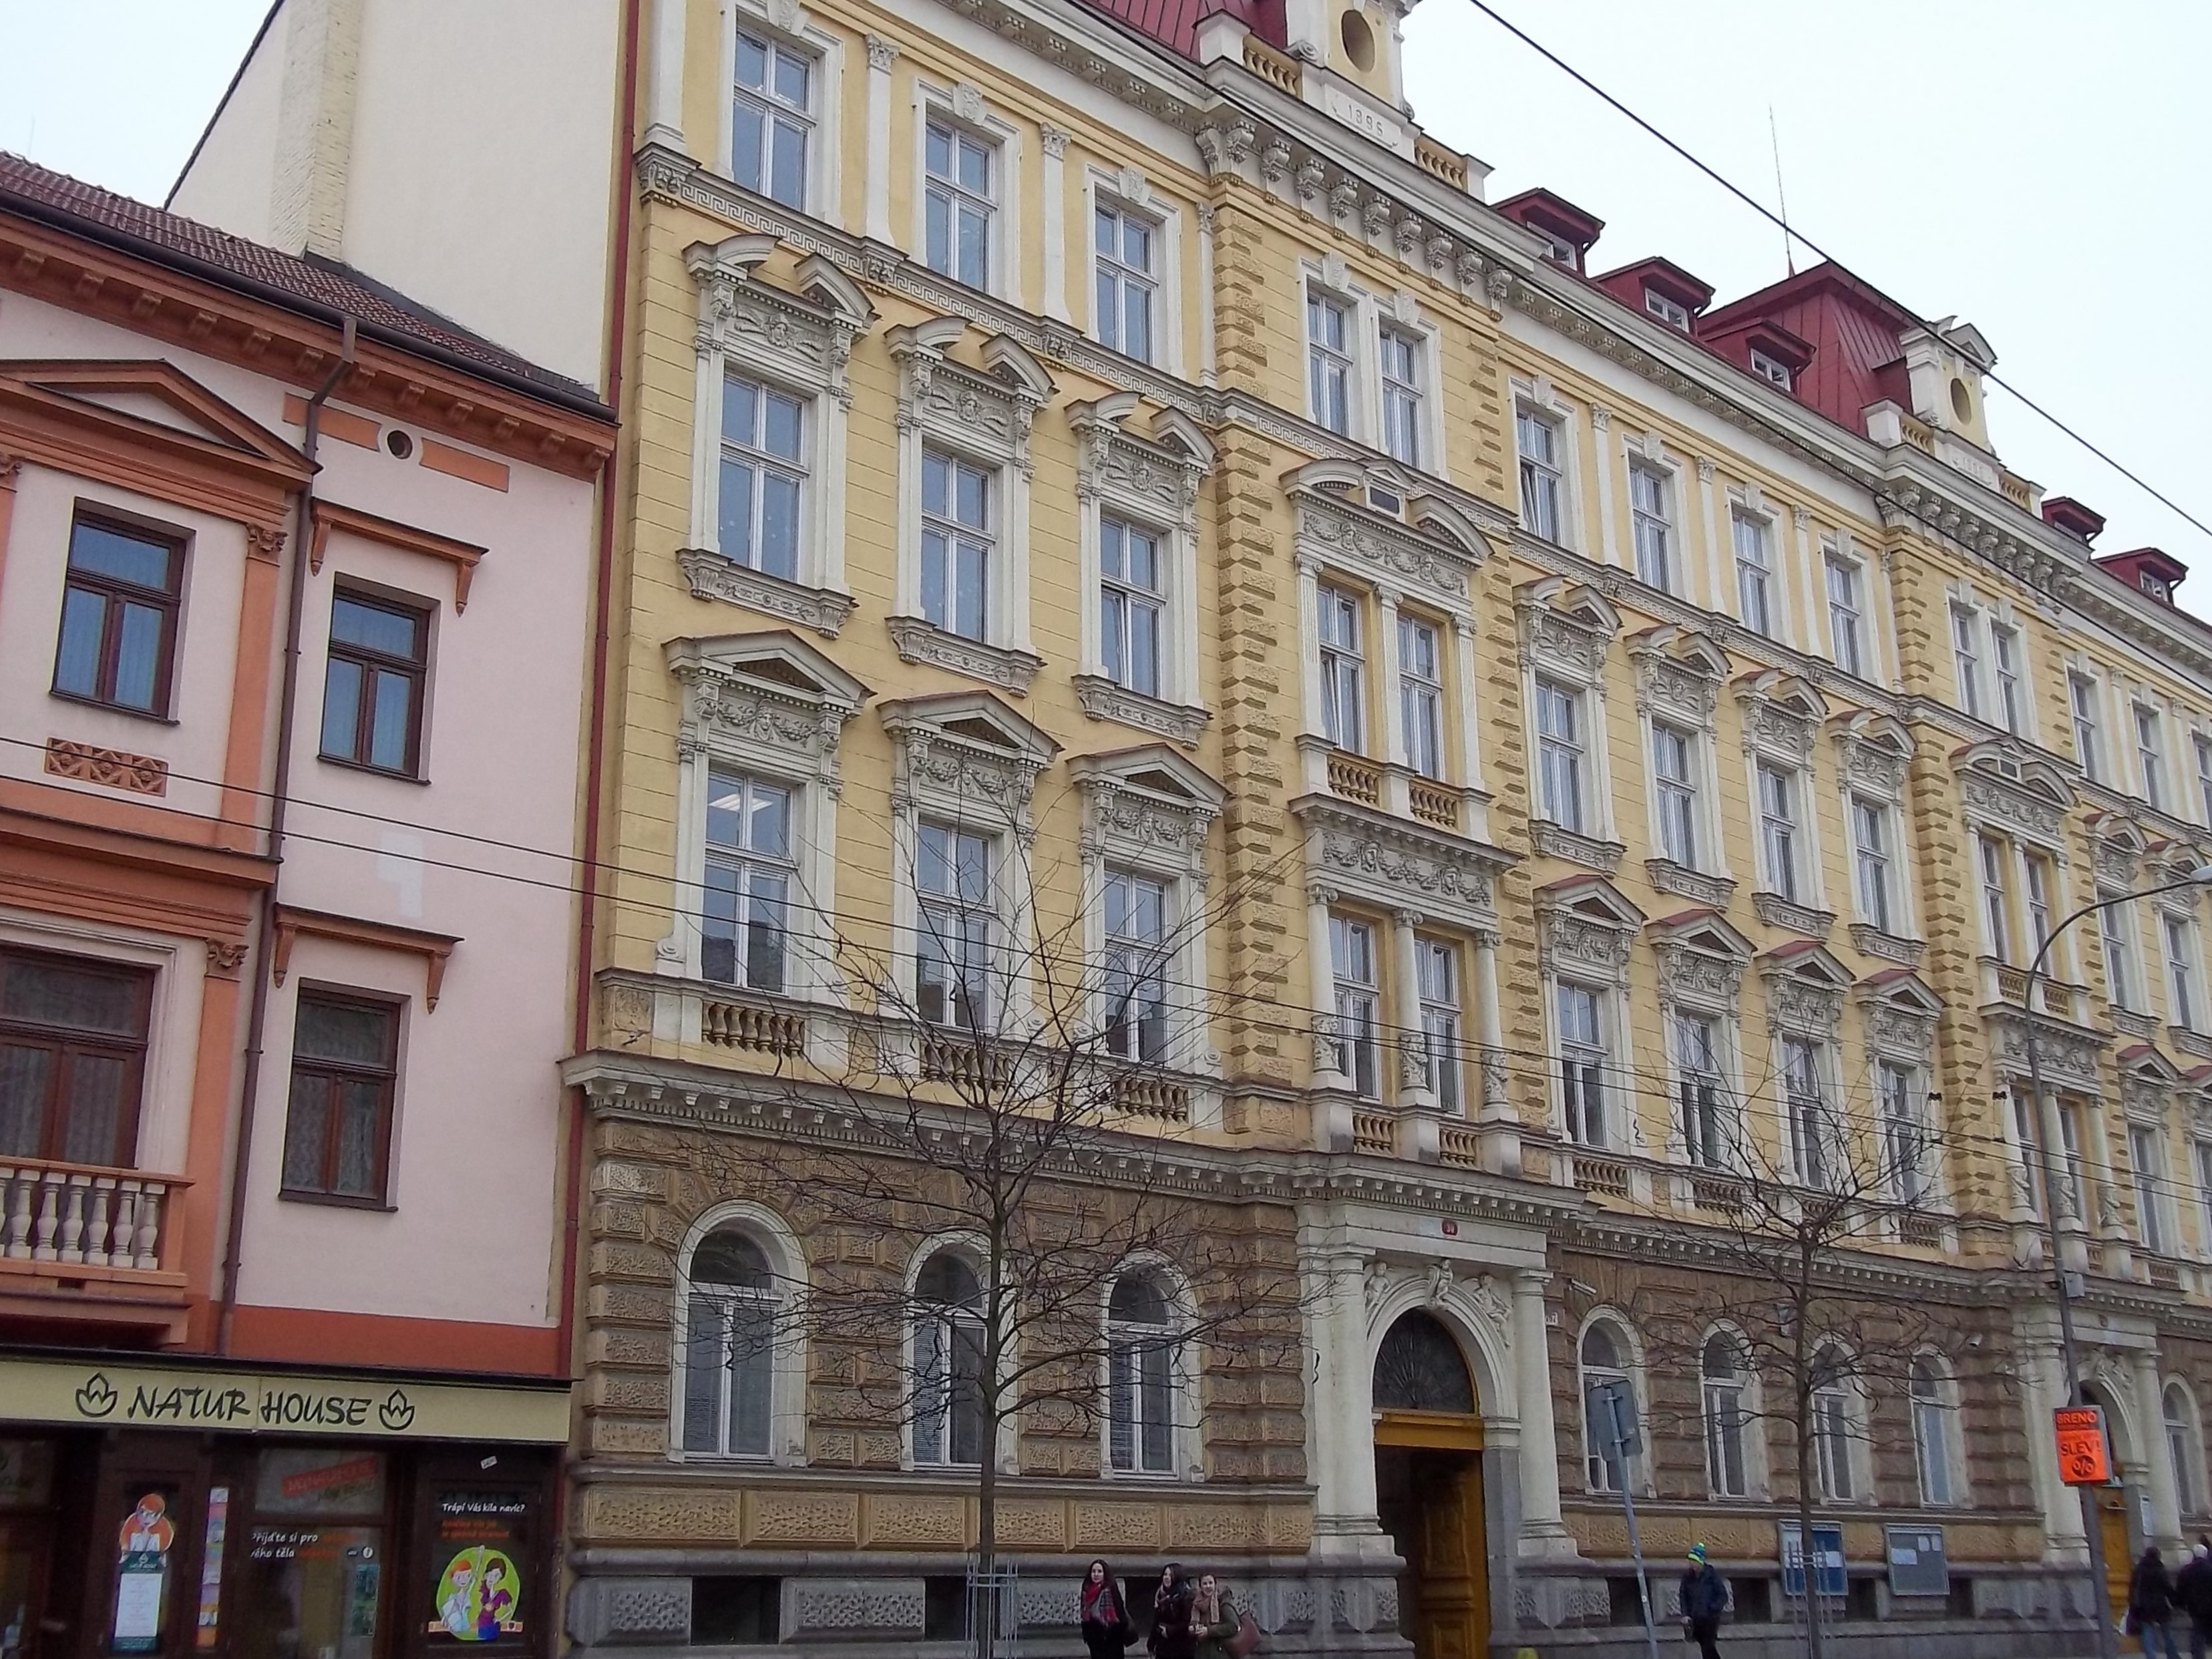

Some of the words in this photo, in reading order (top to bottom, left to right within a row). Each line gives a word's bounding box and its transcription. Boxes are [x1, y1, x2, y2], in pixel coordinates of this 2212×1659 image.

[128, 1386, 252, 1421] NATUR
[260, 1390, 373, 1425] HOUSE
[2056, 1411, 2096, 1424] BRENO
[442, 1502, 466, 1515] Trápí
[468, 1503, 482, 1512] Vás
[482, 1503, 498, 1512] kila
[299, 1535, 319, 1545] pro
[276, 1546, 295, 1557] těla
